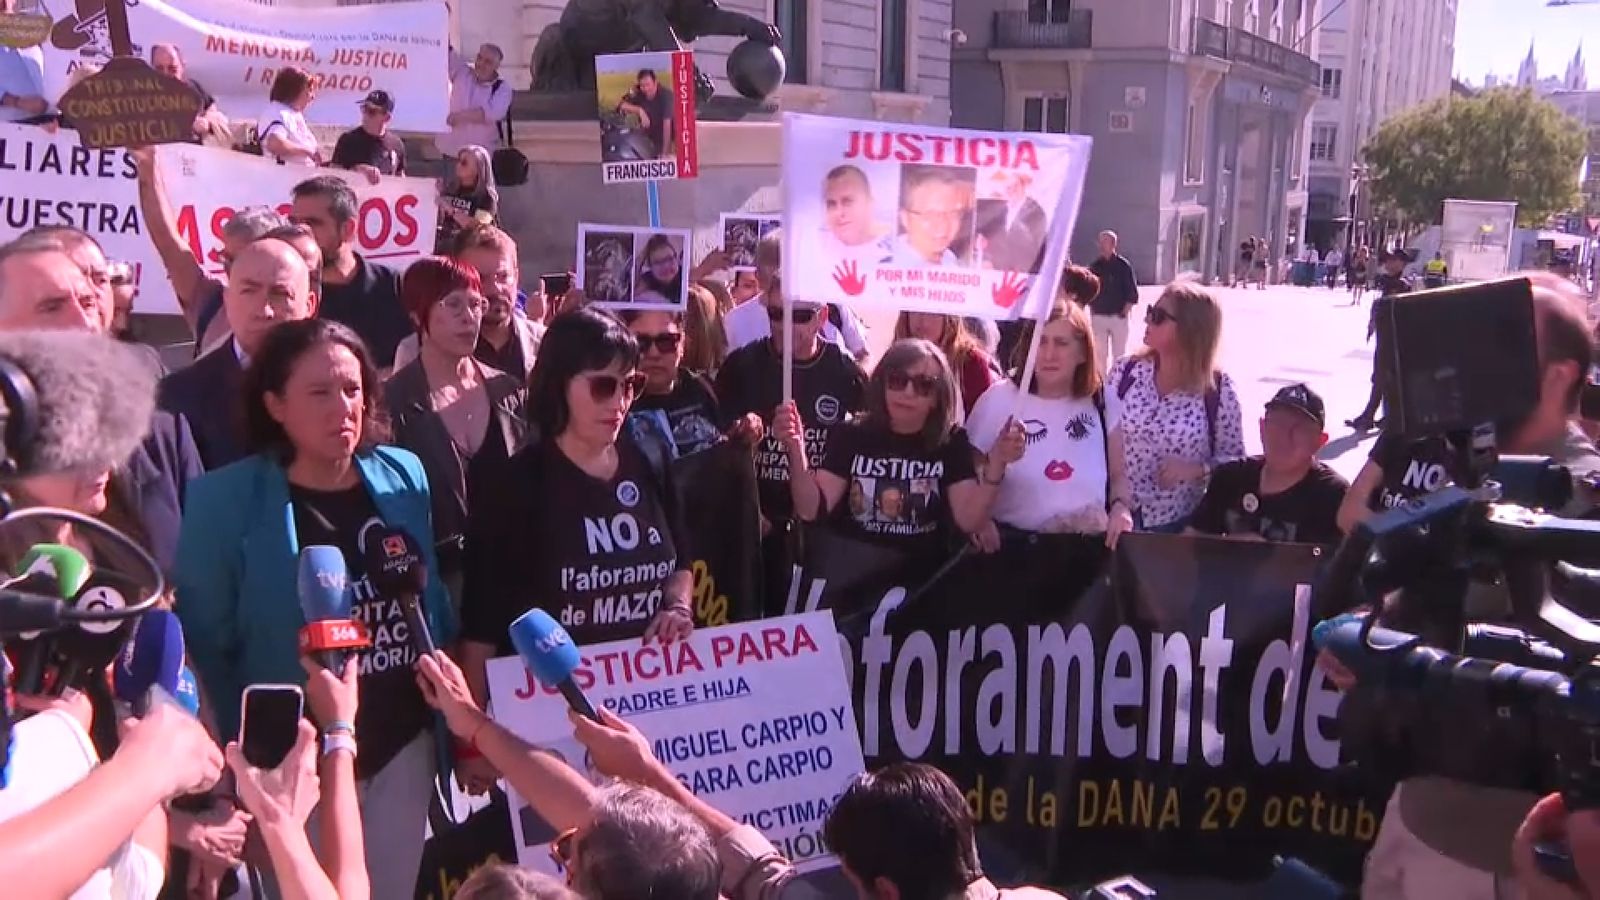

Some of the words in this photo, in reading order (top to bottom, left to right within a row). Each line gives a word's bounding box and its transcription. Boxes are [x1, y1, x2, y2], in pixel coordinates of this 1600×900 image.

[679, 53, 692, 174] JUSTICIA
[843, 130, 1040, 171] JUSTICIA
[607, 161, 676, 181] FRANCISCO
[0, 196, 141, 235] UESTRA
[875, 268, 902, 282] POR
[906, 269, 924, 282] MI
[927, 271, 981, 287] MARIDO
[1402, 459, 1446, 491] NO
[584, 512, 640, 554] NO
[648, 525, 662, 545] a
[560, 603, 586, 627] de
[514, 638, 705, 700] JSTICIA
[711, 622, 819, 668] PARA
[1248, 583, 1343, 769] de
[604, 687, 678, 714] PADRE
[683, 684, 698, 703] E
[703, 676, 751, 700] HIJA
[741, 710, 828, 749] CARPIO
[830, 705, 846, 731] Y
[746, 745, 834, 785] CARPIO
[968, 774, 1008, 823] de
[1026, 775, 1057, 828] la
[1078, 779, 1181, 832] DANA
[1201, 786, 1247, 831] 29
